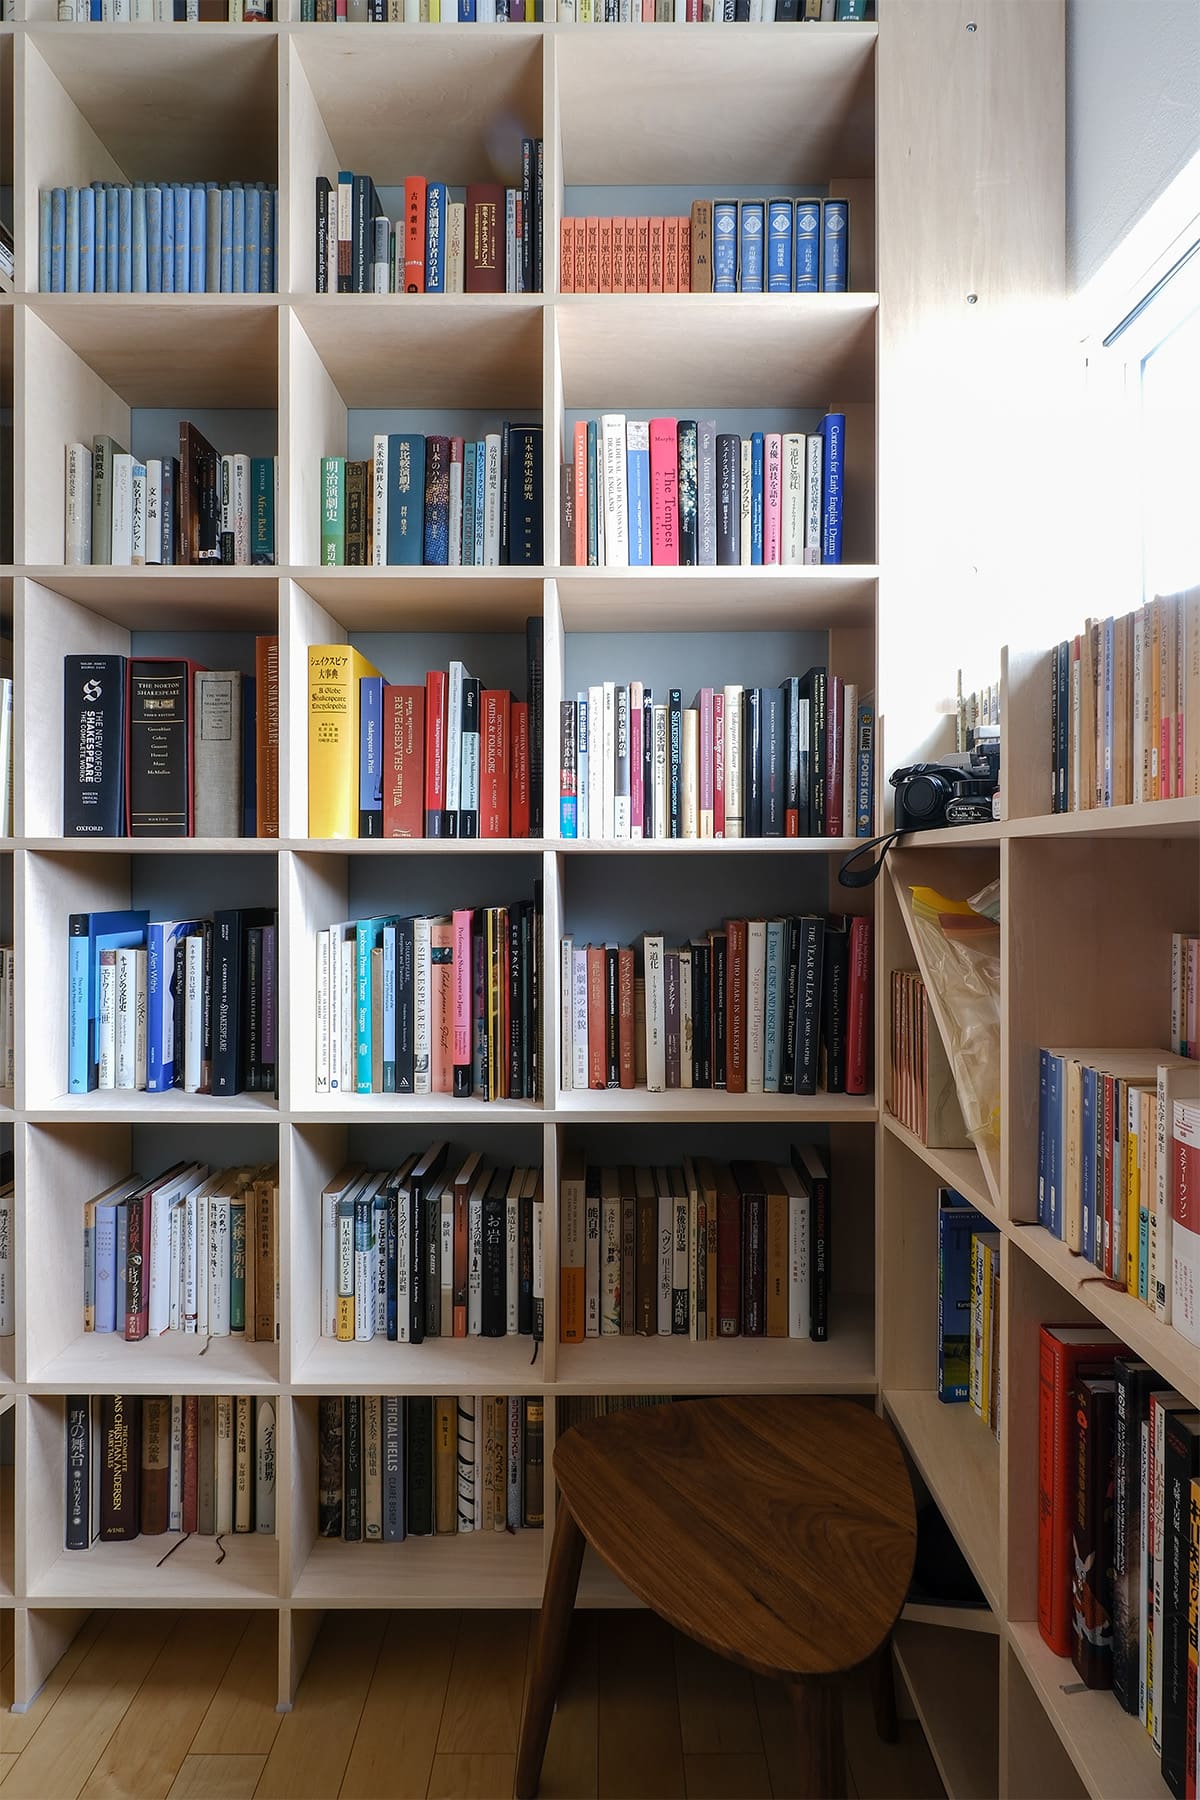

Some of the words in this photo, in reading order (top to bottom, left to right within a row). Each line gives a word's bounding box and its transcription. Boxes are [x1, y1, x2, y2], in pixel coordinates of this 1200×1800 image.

[428, 188, 440, 287] 或る演劇製作者の手記
[562, 229, 570, 286] 夏目漱石作品集
[576, 229, 584, 287] 夏目漱石作品集
[588, 228, 597, 286] 夏目漱石作品集
[600, 228, 610, 286] 夏目漱石作品集
[614, 227, 622, 286] 夏目漱石作品集
[626, 228, 635, 287] 夏目漱石作品集
[638, 228, 647, 286] 夏目漱石作品集
[651, 228, 660, 286] 夏目漱石作品集
[666, 226, 675, 285] 夏目漱石作品集
[680, 228, 689, 286] 夏目漱石作品集
[830, 426, 840, 460] Contexts
[432, 444, 440, 506] 日本のハムレット
[664, 468, 676, 493] The
[828, 474, 839, 494] Early
[830, 461, 840, 473] for
[326, 460, 338, 522] 明治演劇史
[769, 462, 778, 507] 演技を語る
[133, 480, 142, 550] 仮名手本ハムレット
[258, 495, 267, 518] After
[661, 496, 676, 548] Tempest
[828, 496, 838, 525] English
[257, 519, 267, 541] Babel
[829, 528, 838, 555] Drama
[267, 646, 277, 682] WILLIAM
[310, 656, 348, 666] シェイクスピア
[318, 668, 338, 679] 大事典
[267, 686, 278, 744] SHAKESPEARE
[312, 694, 346, 702] Shakespeare
[86, 710, 96, 783] SHAKESPEARE
[394, 696, 403, 770] SHAKESPEARE
[672, 710, 680, 764] SHAKESPEARE
[861, 728, 871, 749] GAME
[860, 753, 869, 787] SPORTS
[393, 773, 402, 806] William
[860, 788, 869, 810] KIDS
[359, 929, 367, 956] Jacobean
[455, 927, 464, 959] Performing
[769, 940, 777, 961] Davis
[807, 944, 816, 968] YEAR
[359, 956, 367, 976] Private
[455, 960, 464, 993] Shakespeare
[650, 952, 659, 969] 道化
[768, 966, 776, 989] GUISE
[807, 970, 814, 981] OF
[359, 977, 367, 1000] Theatre
[417, 947, 425, 1040] SHAKESPEARE'S
[437, 967, 450, 1014] Shakespeare
[576, 962, 586, 1031] 演劇論の変貌
[751, 968, 761, 995] Stages
[768, 990, 776, 1007] AND
[805, 983, 815, 1008] LEAR
[832, 964, 840, 1015] Shakespeare's
[456, 1001, 464, 1017] Japan
[220, 1004, 229, 1052] SHAKESPEARE
[751, 1015, 760, 1053] Playgoers
[767, 1009, 776, 1044] DISGUISE
[1179, 1148, 1188, 1219] スティーヴンソン
[218, 1203, 227, 1234] 一人の男が
[486, 1215, 501, 1244] お岩
[507, 1206, 516, 1243] 構造と力
[342, 1221, 351, 1291] 日本語が亡びるとき
[661, 1228, 671, 1255] ヘヴン
[662, 1257, 671, 1299] 川上未映子
[71, 1410, 85, 1466] 野の舞台
[114, 1414, 123, 1461] CHRISTIAN
[387, 1445, 398, 1472] HELLS
[113, 1463, 122, 1510] ANDERSEN
[388, 1477, 396, 1501] CLAIRE
[388, 1502, 396, 1526] BISHOP
